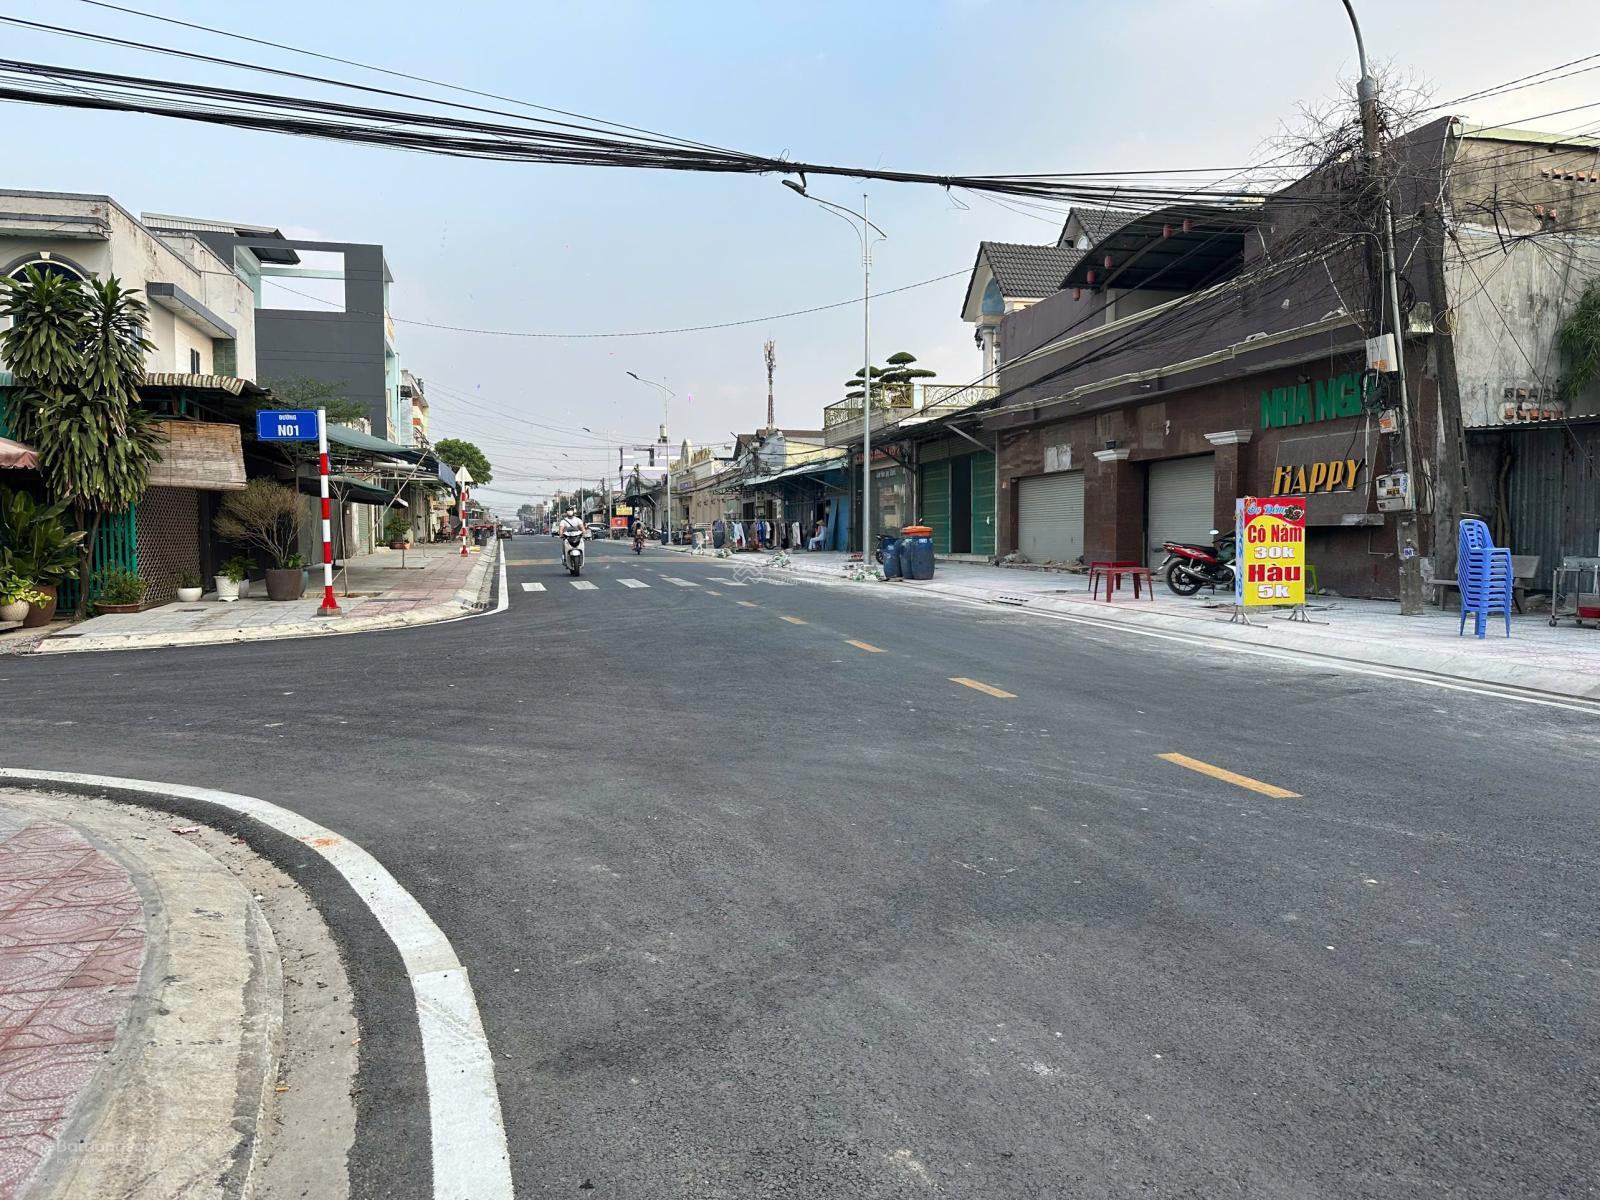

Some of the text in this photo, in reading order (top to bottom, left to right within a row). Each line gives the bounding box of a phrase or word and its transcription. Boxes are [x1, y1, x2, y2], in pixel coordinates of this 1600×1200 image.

[1272, 459, 1364, 495] HAPPY
[1247, 523, 1302, 543] Cô Năm
[1248, 563, 1300, 582] Hàu
